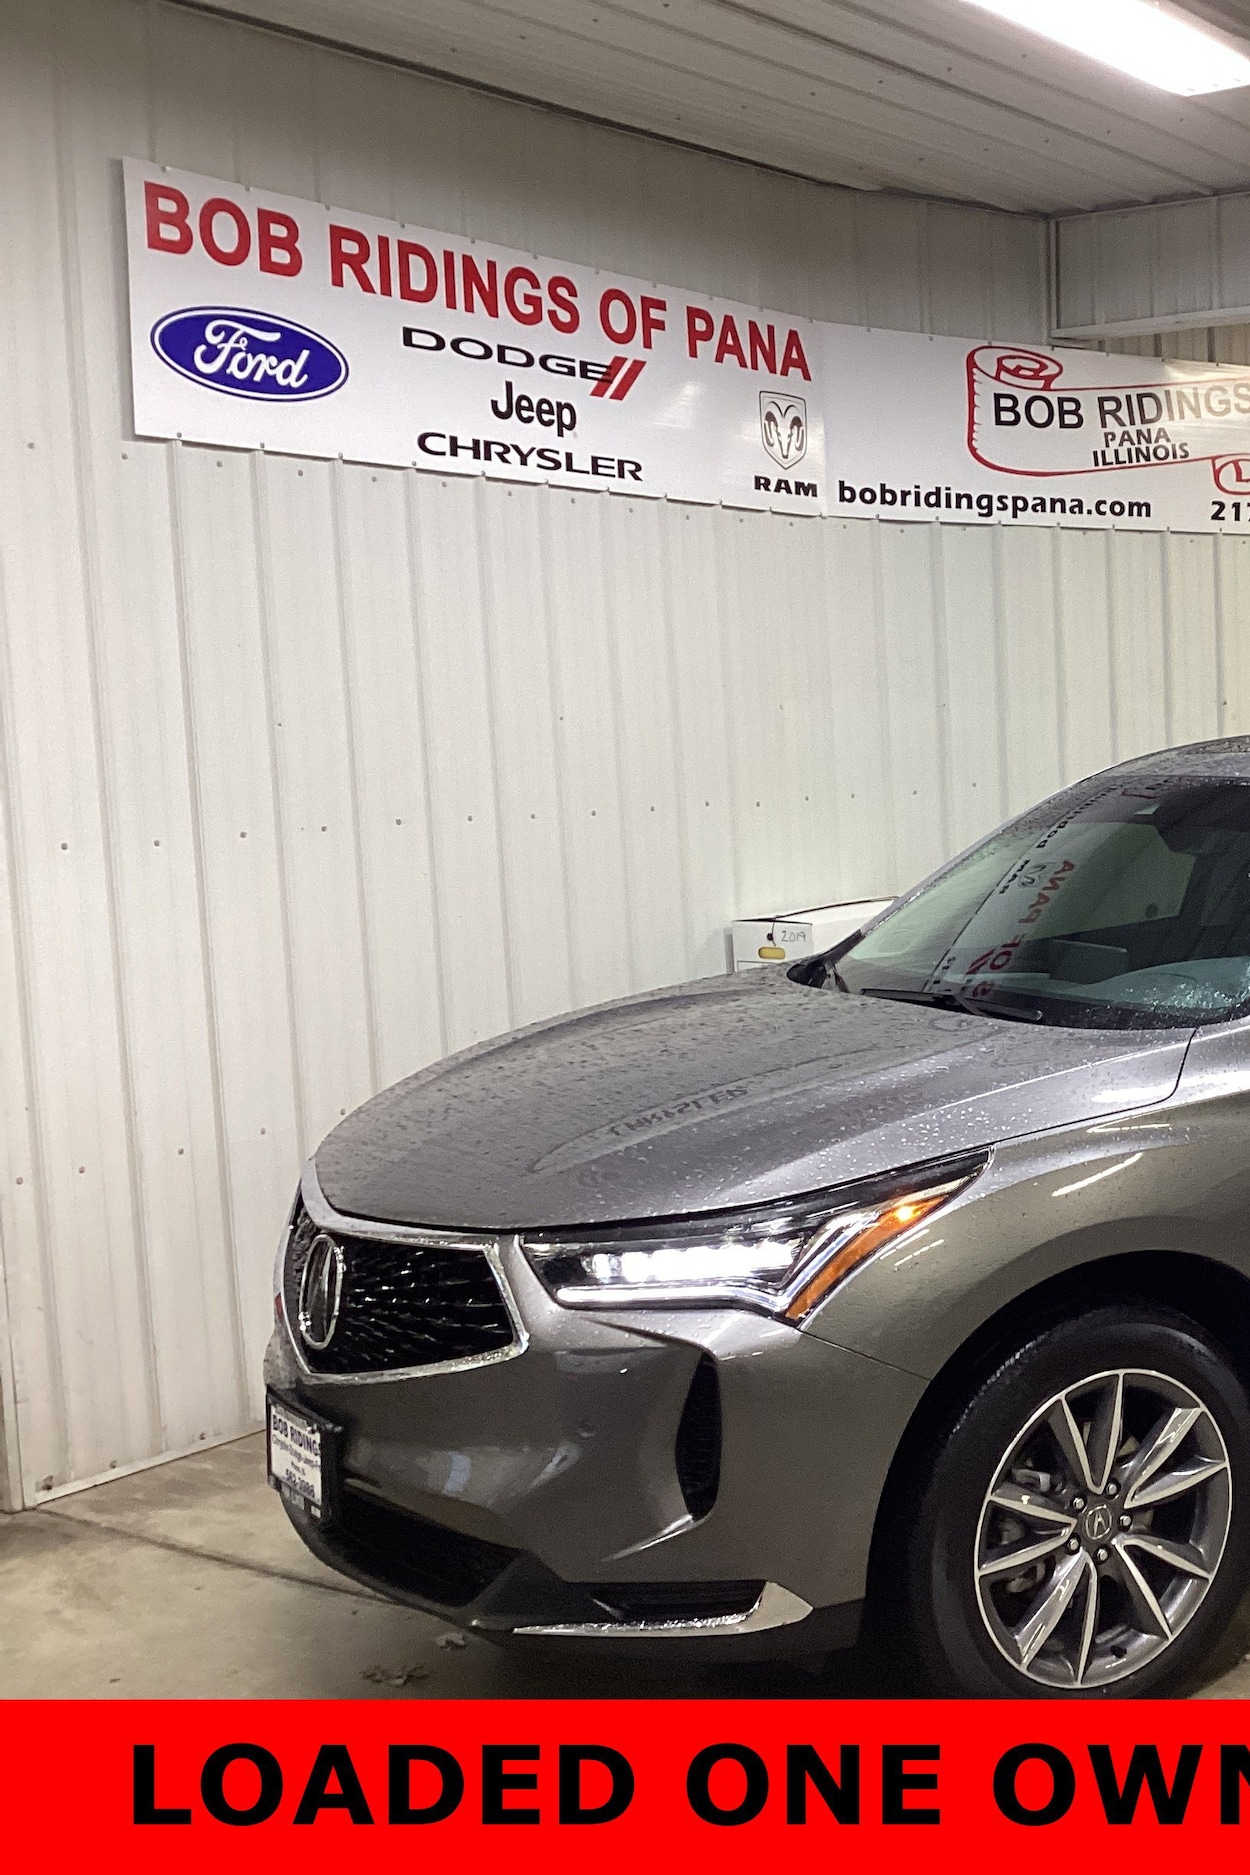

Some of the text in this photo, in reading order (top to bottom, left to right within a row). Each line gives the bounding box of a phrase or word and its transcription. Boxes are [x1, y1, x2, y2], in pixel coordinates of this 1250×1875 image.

[144, 181, 812, 382] BOB RIDINGS OF PANA
[193, 318, 310, 390] Ford
[402, 326, 616, 384] DODGE
[490, 380, 577, 437] Jeep
[992, 392, 1084, 429] BOB
[1092, 441, 1190, 468] ILLINOIS
[1103, 427, 1170, 447] PANA
[416, 432, 643, 482] CHRYSLER
[753, 475, 818, 498] RAM
[838, 480, 1152, 518] bobridingspana.com
[780, 931, 807, 943] 2019
[272, 1414, 289, 1438] BOB
